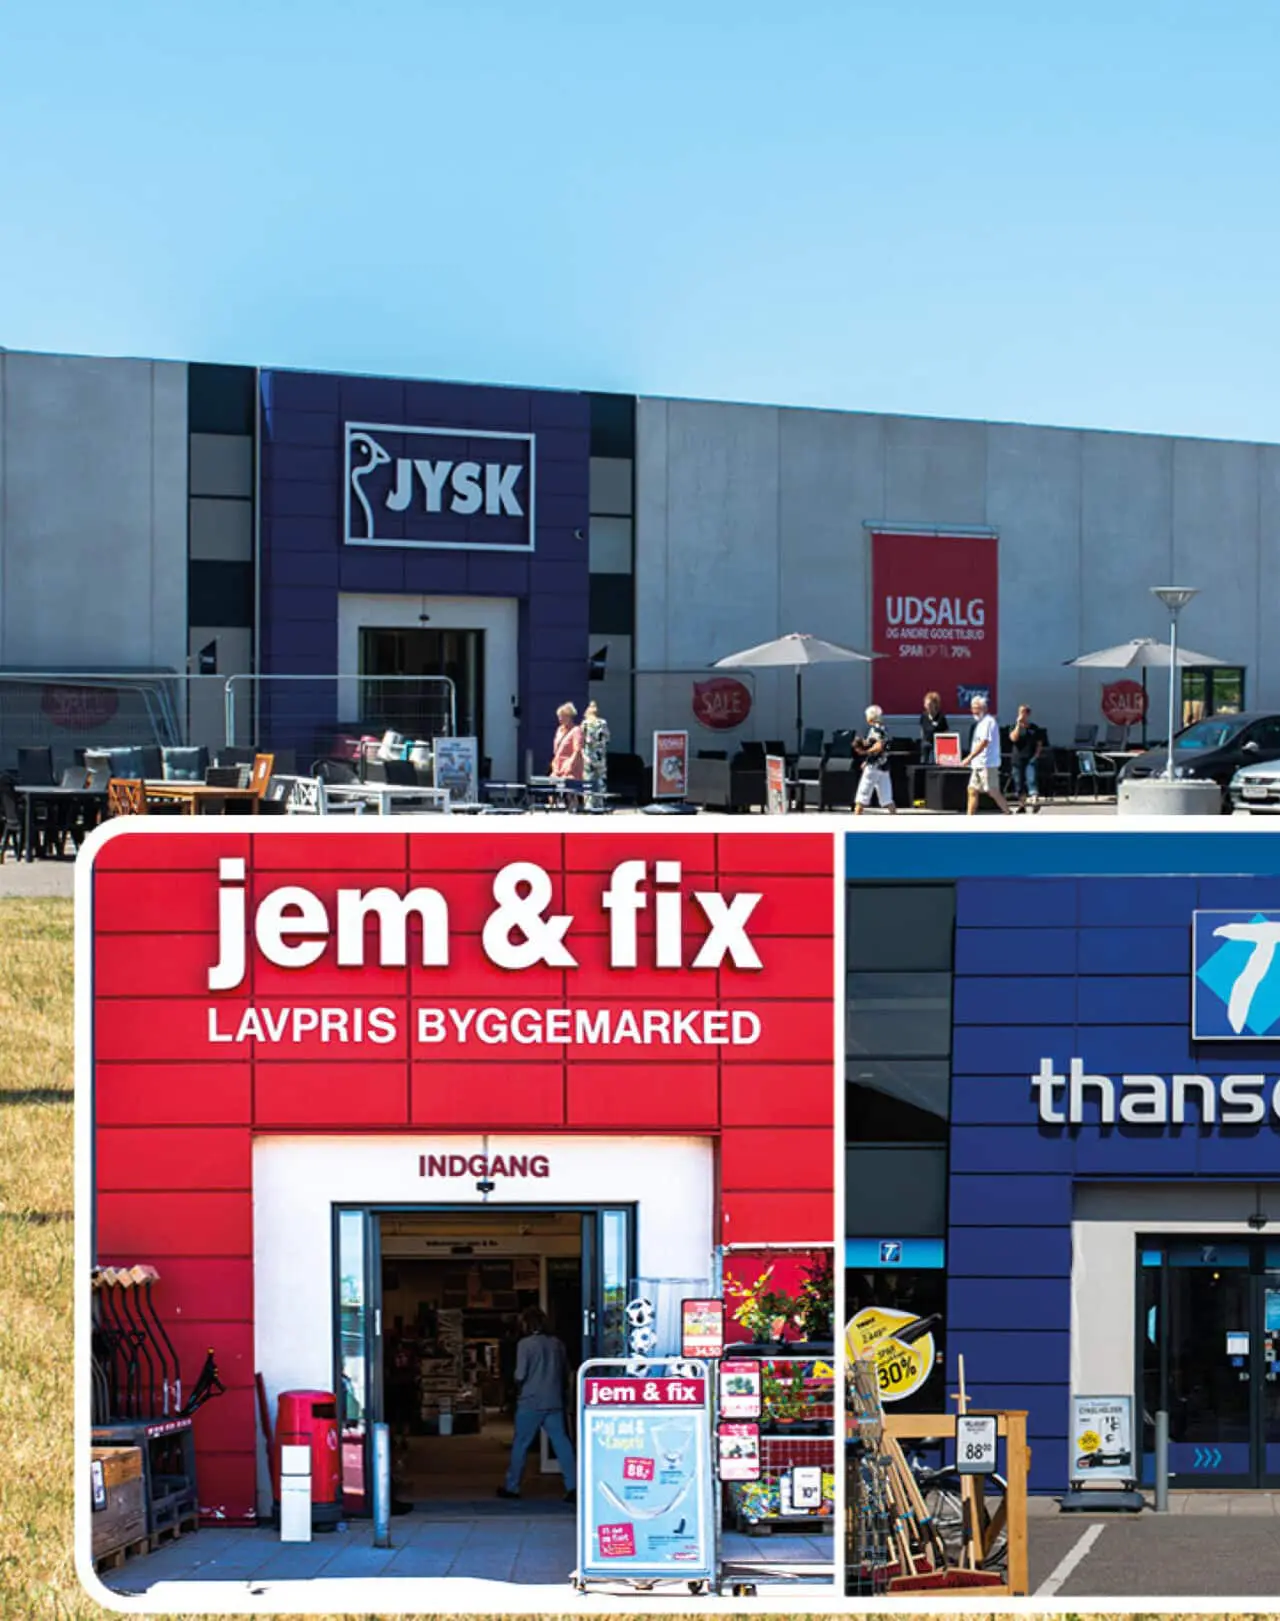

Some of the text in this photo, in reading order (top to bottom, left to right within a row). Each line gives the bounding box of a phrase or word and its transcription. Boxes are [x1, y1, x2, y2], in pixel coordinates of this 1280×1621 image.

[385, 457, 525, 518] JYSK
[886, 596, 985, 626] UDSALG
[886, 627, 899, 639] OG
[899, 644, 923, 657] SPAR
[702, 691, 742, 713] SALE
[207, 857, 764, 991] jem & fix
[207, 1007, 761, 1045] LAVPRIS BYGGEMARKED
[418, 1154, 550, 1178] INDGANG
[877, 1355, 917, 1390] 30%
[589, 1382, 698, 1405] jem & fix
